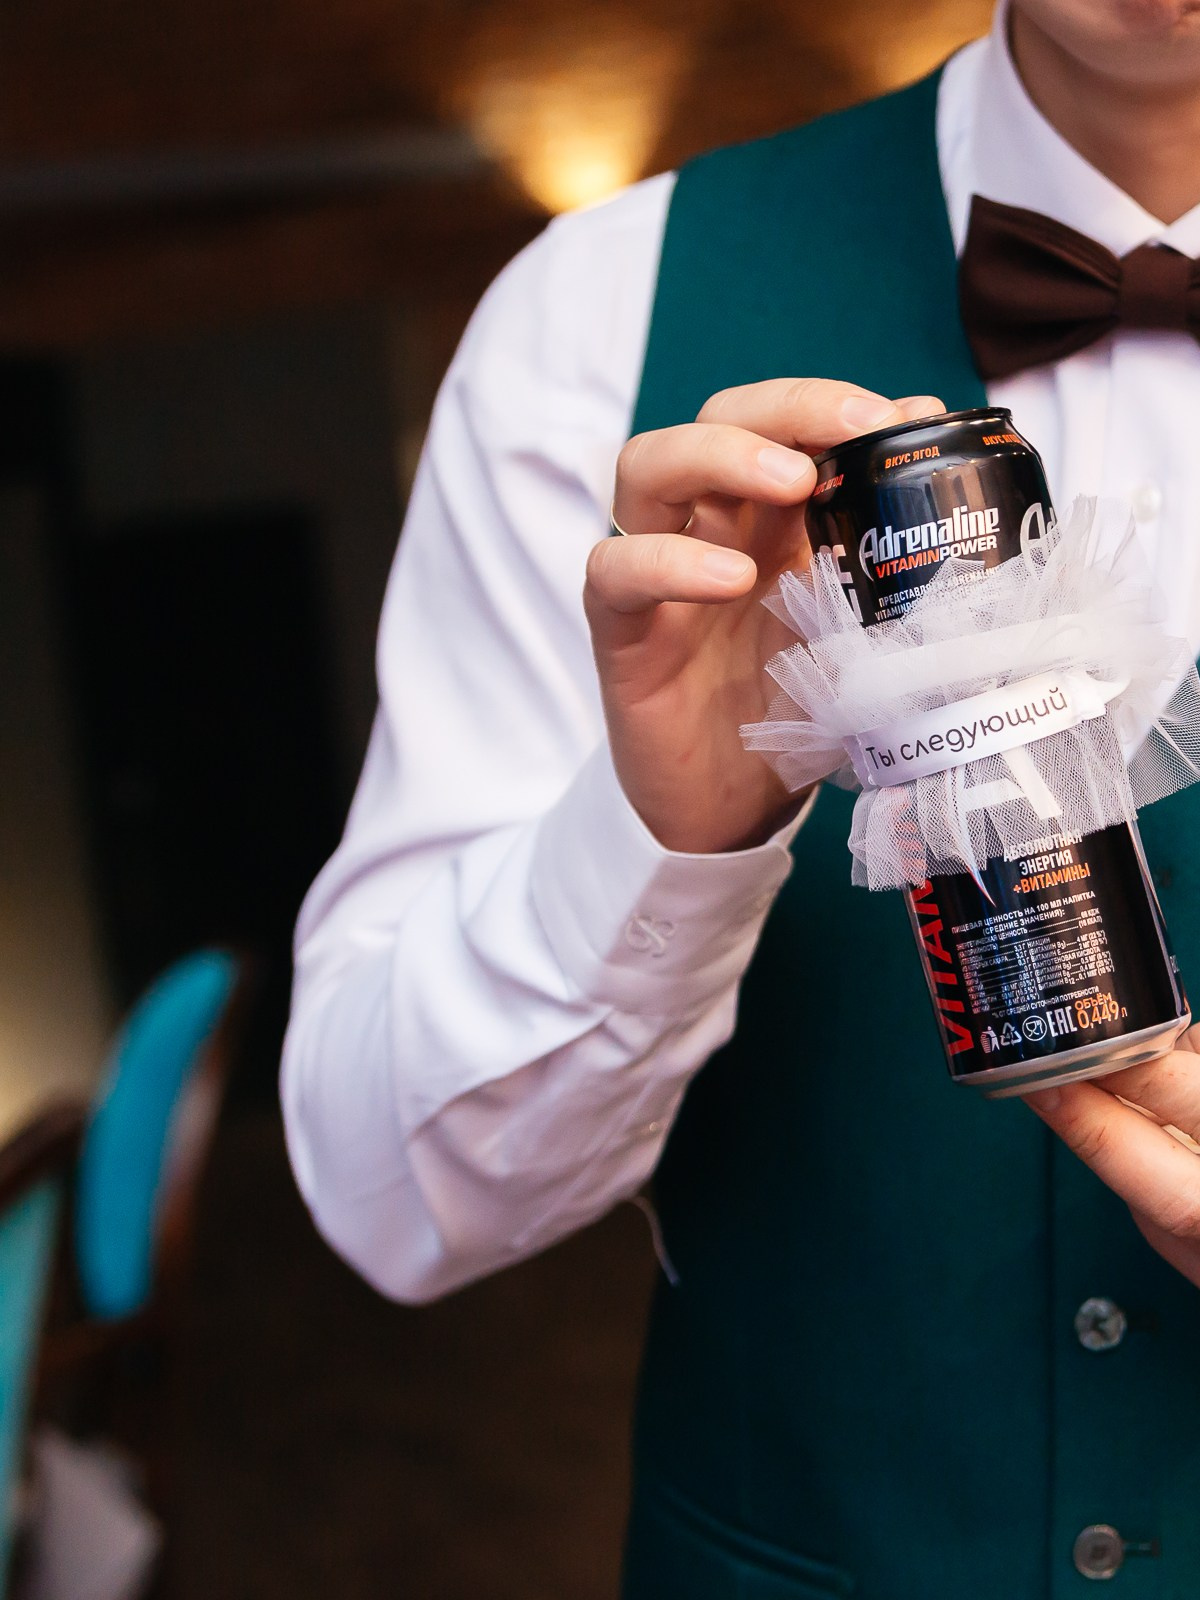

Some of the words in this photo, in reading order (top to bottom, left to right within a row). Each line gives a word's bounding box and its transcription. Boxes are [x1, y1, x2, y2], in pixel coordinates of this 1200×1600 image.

[885, 453, 911, 469] ВКУС
[912, 445, 940, 462] ЯГОД
[859, 505, 1000, 582] Adrenaline
[865, 746, 896, 770] Ты
[900, 687, 1068, 752] следующий
[1003, 829, 1083, 862] АБСОЛЮТНАЯ
[1019, 849, 1074, 876] ЭНЕРГИЯ
[1013, 863, 1091, 894] +ВИТАМИНЫ
[951, 920, 983, 934] ПИЩЕВАЯ
[984, 909, 1023, 927] ЦЕННОСТЬ
[1024, 907, 1035, 915] НА
[1036, 903, 1049, 912] 100
[1050, 899, 1062, 908] МЛ
[1062, 891, 1096, 905] НАПИТКА
[983, 920, 1019, 935] (СРЕДНИЕ
[1020, 909, 1065, 926] ЗНАЧЕНИЯ):
[998, 927, 1027, 940] ЦЕННОСТЬ
[1074, 992, 1113, 1011] ОБЪЁМ
[1077, 1001, 1120, 1030] 0,449
